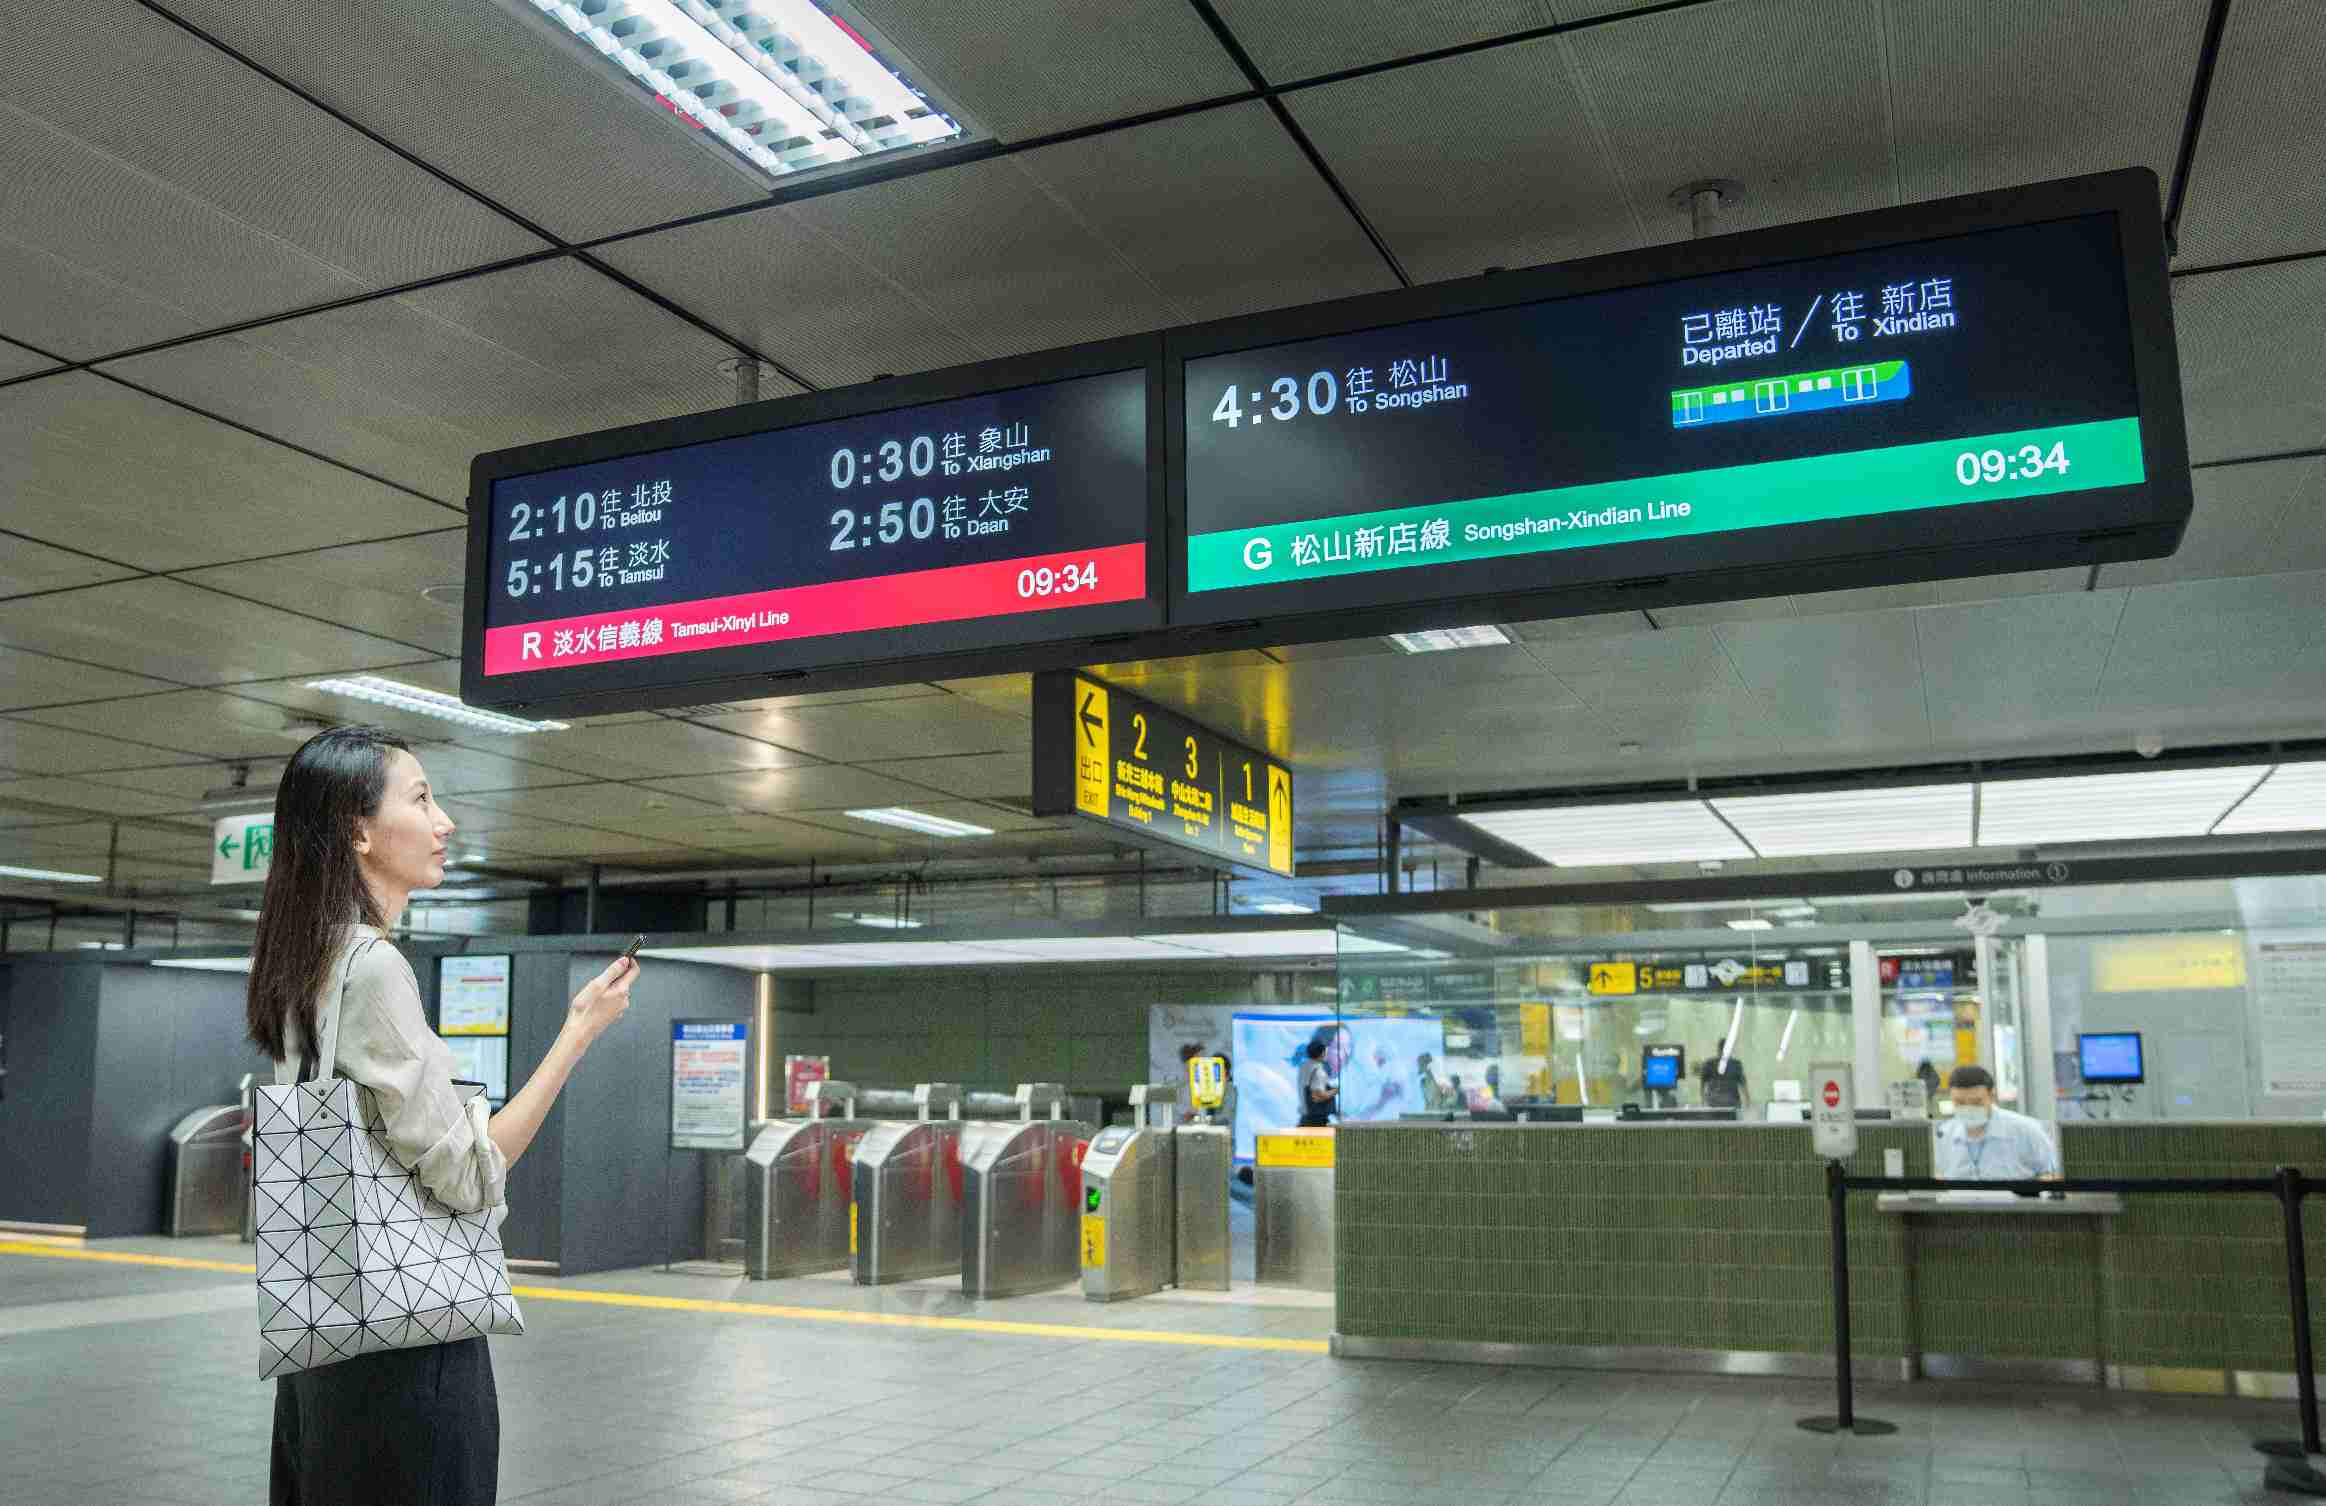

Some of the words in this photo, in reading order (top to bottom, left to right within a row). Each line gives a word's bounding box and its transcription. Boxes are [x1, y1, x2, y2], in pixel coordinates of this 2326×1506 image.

[1681, 304, 1781, 344] 已離站
[1831, 291, 1866, 322] 往
[1881, 278, 1952, 315] 新店
[1682, 336, 1777, 366] Departed
[1832, 324, 1859, 342] To
[1873, 311, 1955, 337] Xindian
[1346, 367, 1374, 396] 往
[1389, 355, 1447, 389] 松山
[1212, 371, 1337, 428] 4:30
[1346, 397, 1367, 414] To
[1375, 383, 1468, 410] Songshan
[941, 461, 961, 476] To
[967, 447, 1050, 473] Xiangshan
[942, 432, 967, 460] 往
[979, 422, 1028, 453] 象山
[831, 436, 934, 489] 0:30
[1956, 441, 2070, 486] 09:34
[509, 492, 596, 542] 2:10
[602, 488, 623, 513] 往
[630, 480, 673, 510] 北投
[942, 495, 968, 522] 往
[978, 486, 1029, 518] 大安
[600, 515, 616, 530] To
[620, 508, 662, 528] Beitou
[830, 497, 935, 551] 2:50
[941, 523, 961, 539] To
[967, 518, 1009, 536] Daan
[1242, 537, 1272, 571] G
[1290, 517, 1453, 567] 松山新店線
[1464, 505, 1641, 543] Songshan-Xindian
[1647, 499, 1691, 521] Line
[507, 549, 595, 598] 5:15
[600, 547, 620, 571] 往
[628, 538, 671, 567] 淡水
[598, 572, 613, 588] To
[618, 564, 664, 585] Tamsui
[1017, 560, 1099, 599] 09:34
[522, 631, 543, 660] R
[553, 618, 664, 657] 淡水信義線
[671, 613, 755, 639] Tamsui-Xinyi
[759, 610, 790, 628] Line
[1133, 713, 1149, 760] 2
[1185, 736, 1199, 780] 3
[1242, 762, 1253, 801] 1
[1967, 868, 2040, 881] Information
